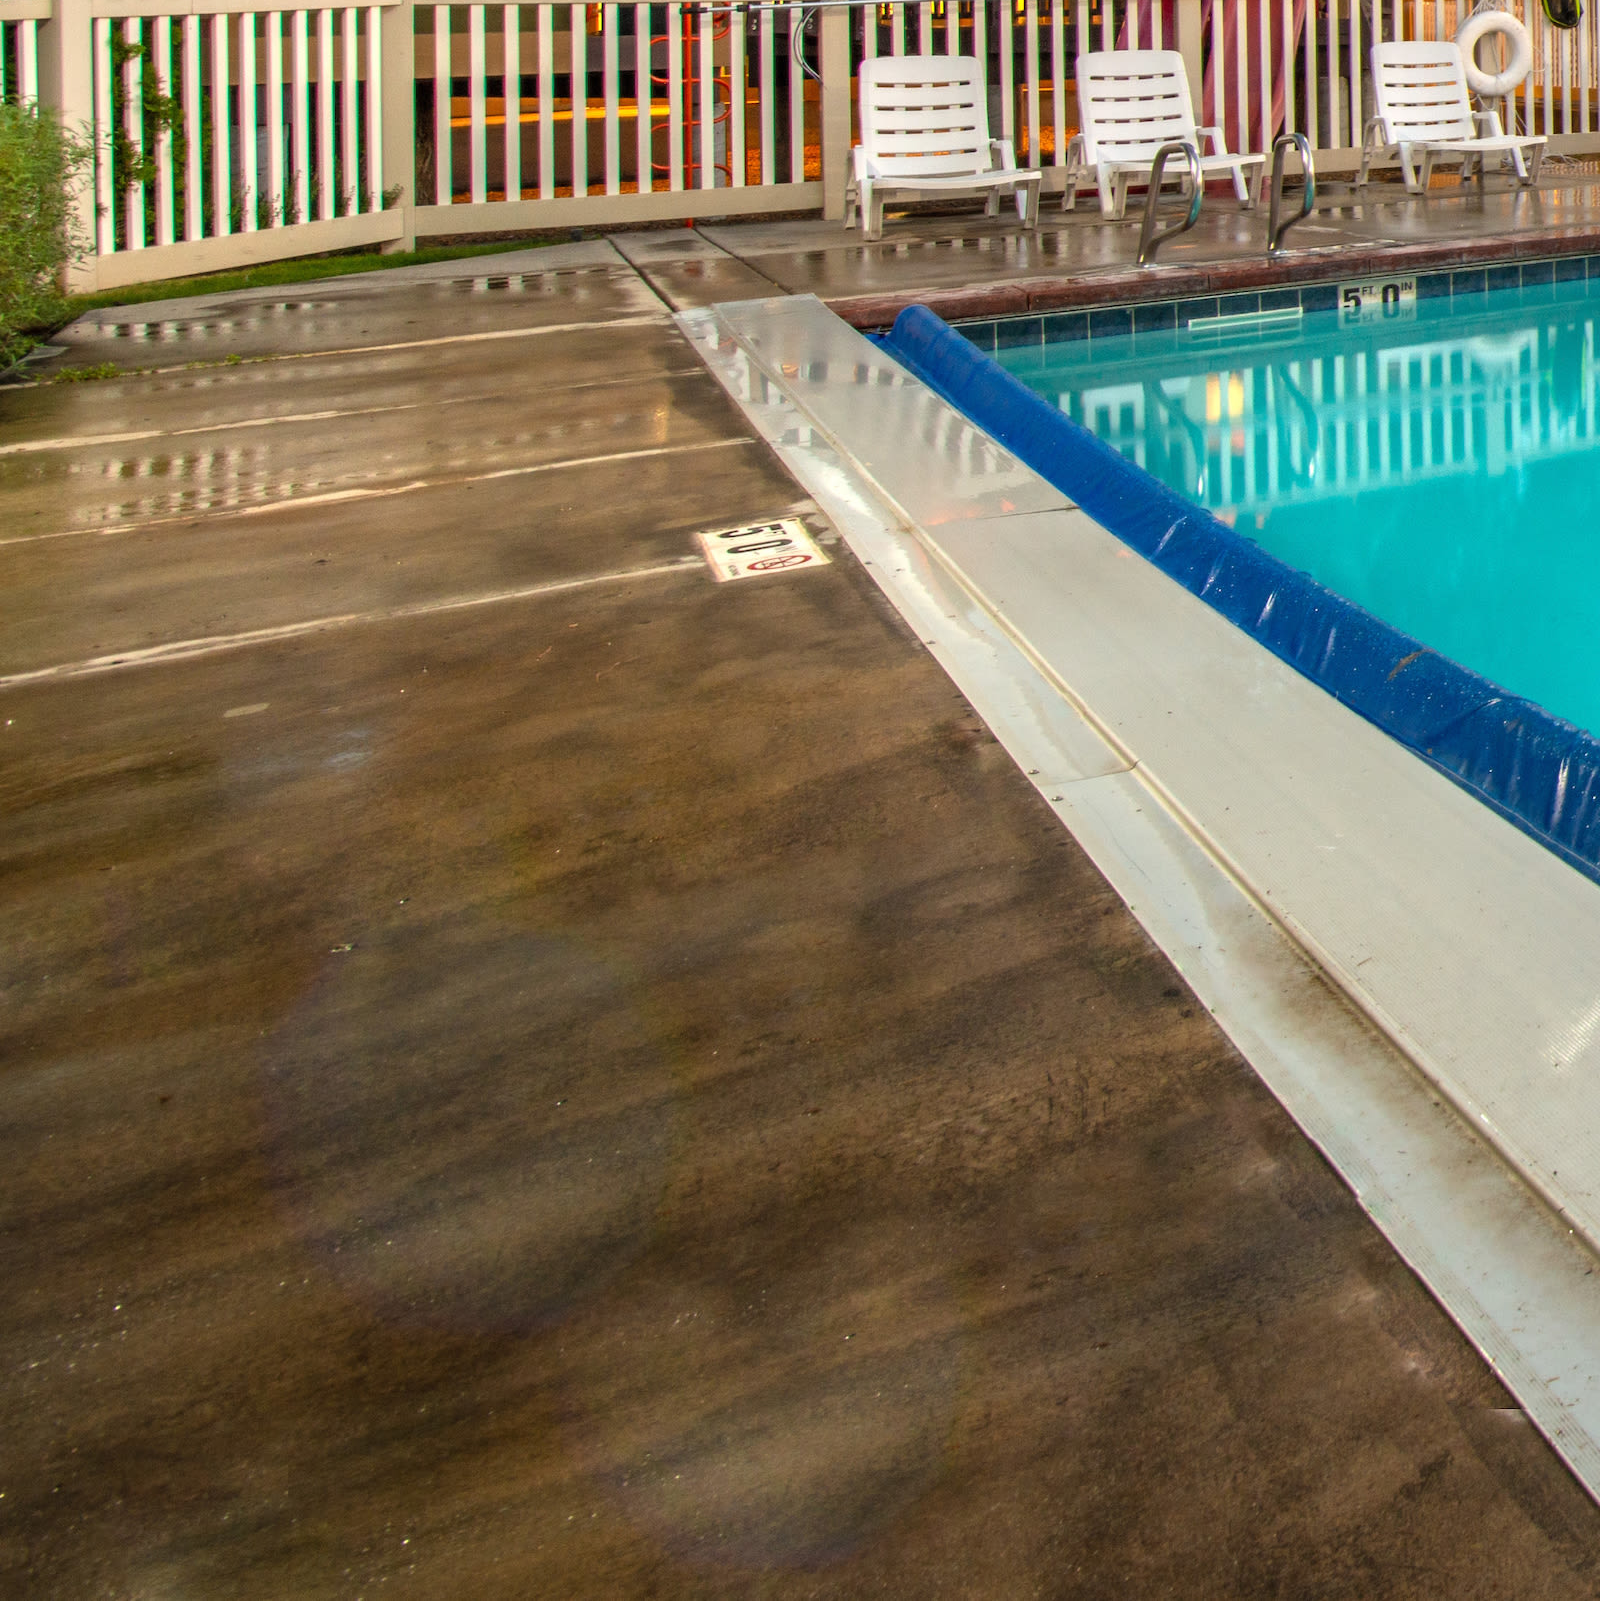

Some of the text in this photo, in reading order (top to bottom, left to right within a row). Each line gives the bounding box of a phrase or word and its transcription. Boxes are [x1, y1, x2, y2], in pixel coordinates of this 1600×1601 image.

[1343, 281, 1413, 308] 5 FT 0 IN
[717, 523, 784, 539] 5
[727, 538, 793, 554] 0
